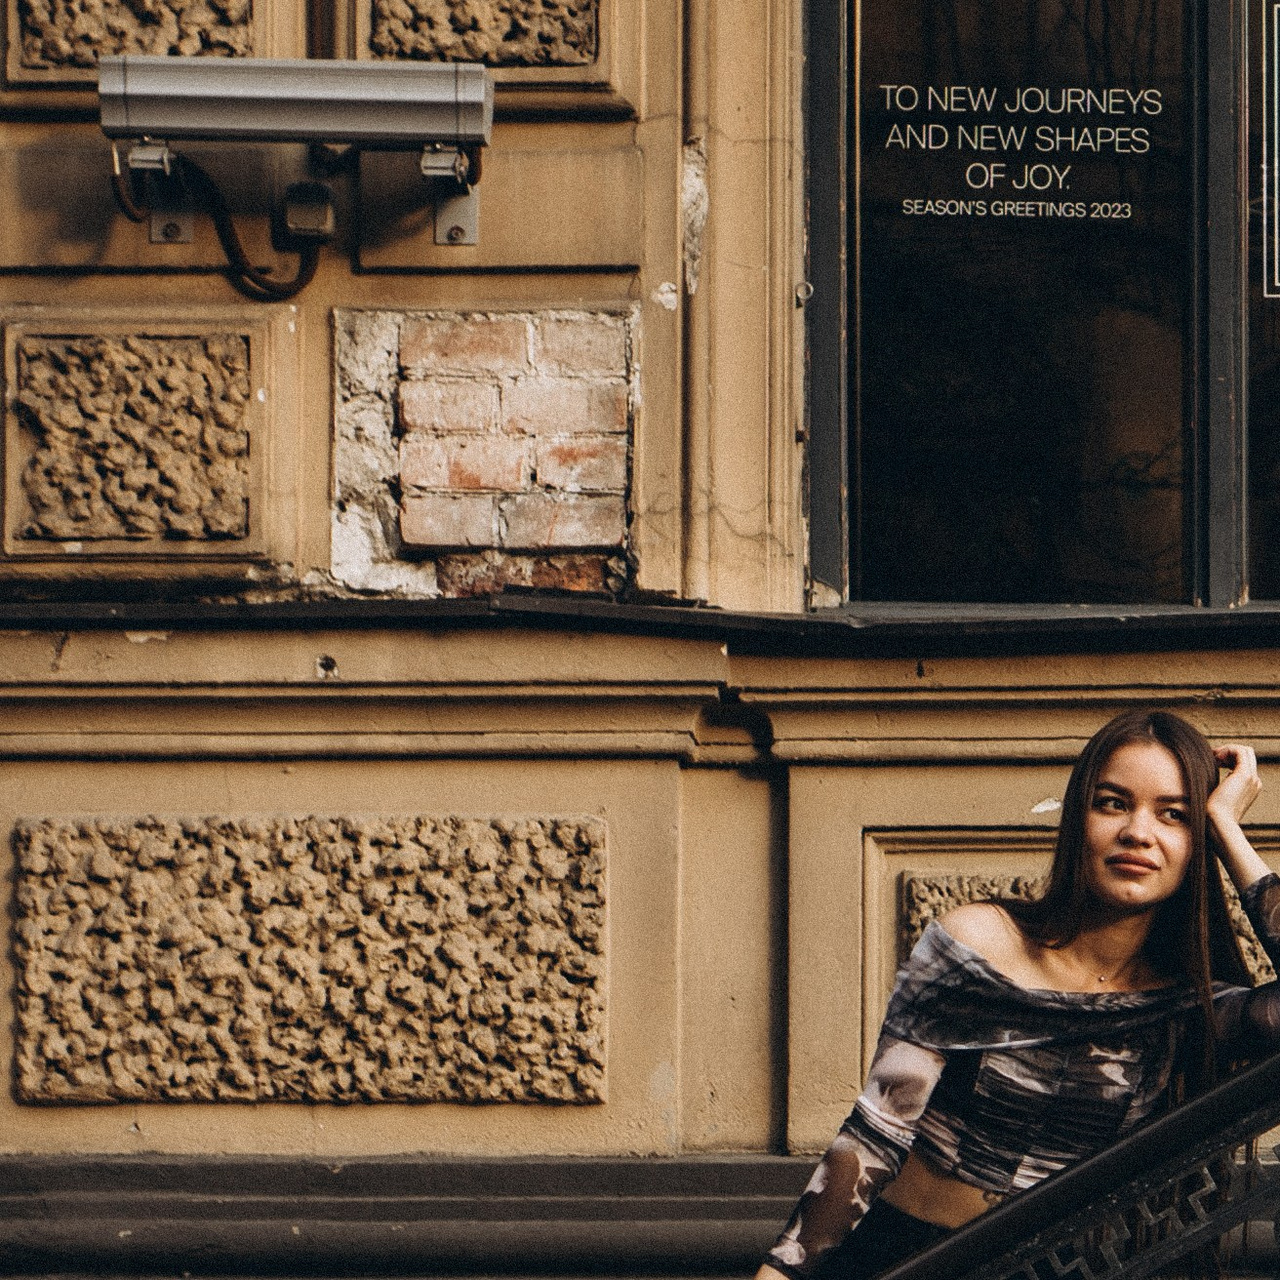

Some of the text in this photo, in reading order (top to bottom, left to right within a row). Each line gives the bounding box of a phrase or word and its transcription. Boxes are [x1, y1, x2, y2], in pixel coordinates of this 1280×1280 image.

[880, 84, 1163, 115] TO NEW JOURNEYS
[885, 124, 1150, 154] AND NEW SHAPES
[965, 162, 1071, 191] OF JOY.
[902, 198, 1133, 219] SEASON'S GREETINGS 2023
